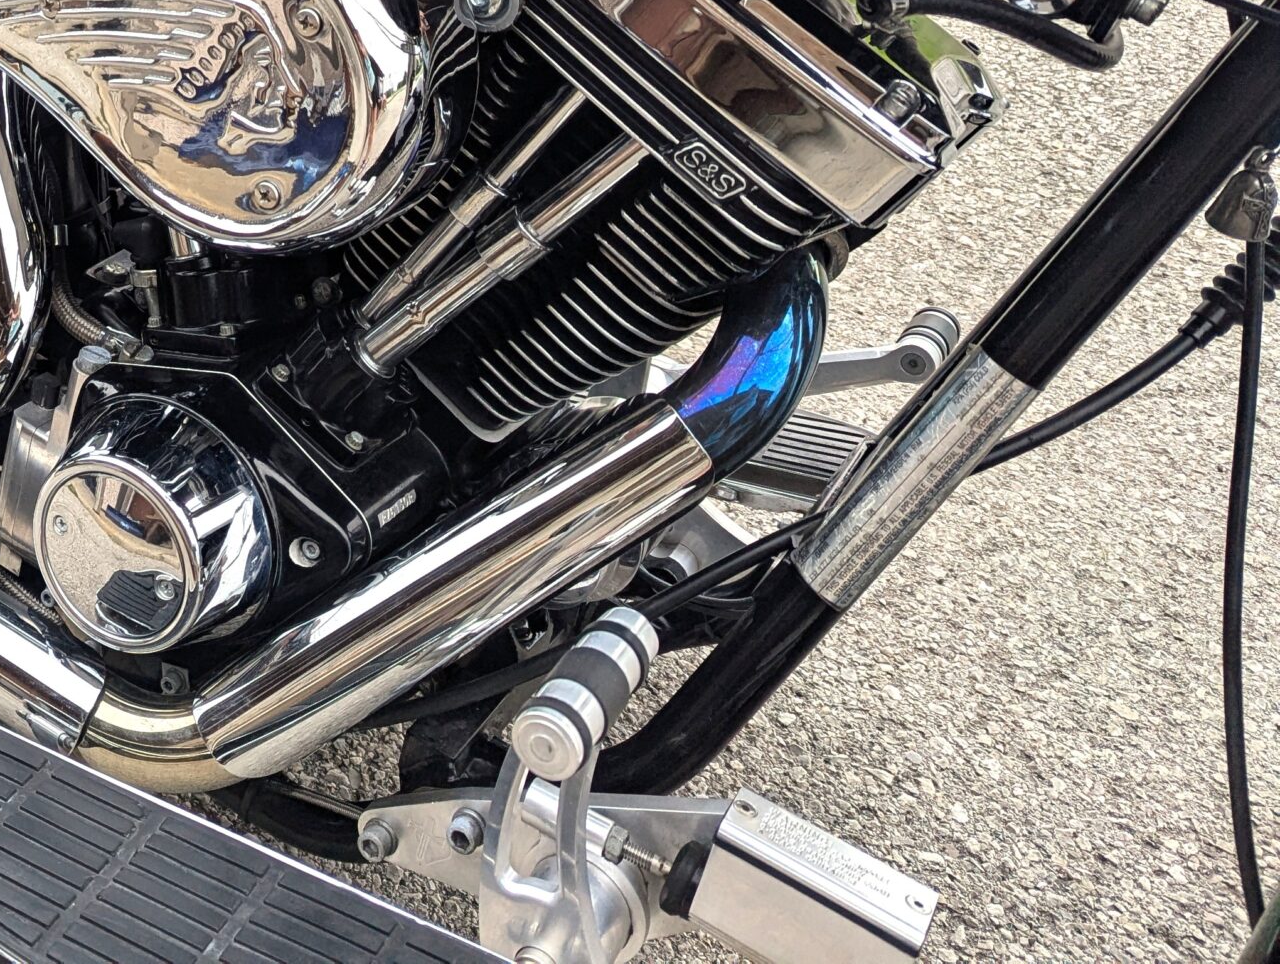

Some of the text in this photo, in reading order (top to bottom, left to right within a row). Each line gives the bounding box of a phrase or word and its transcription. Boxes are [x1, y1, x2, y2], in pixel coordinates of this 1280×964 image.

[683, 150, 736, 193] S&S
[972, 365, 990, 383] COLD
[825, 578, 840, 594] THIS
[836, 558, 858, 582] VEHICLE
[880, 522, 891, 533] TO
[888, 512, 901, 524] ALL
[898, 482, 928, 514] APPLICABLE
[935, 448, 959, 473] FEDERAL
[956, 428, 978, 450] MOTOR
[975, 405, 998, 430] VEHICLE
[994, 386, 1016, 409] SAFETY
